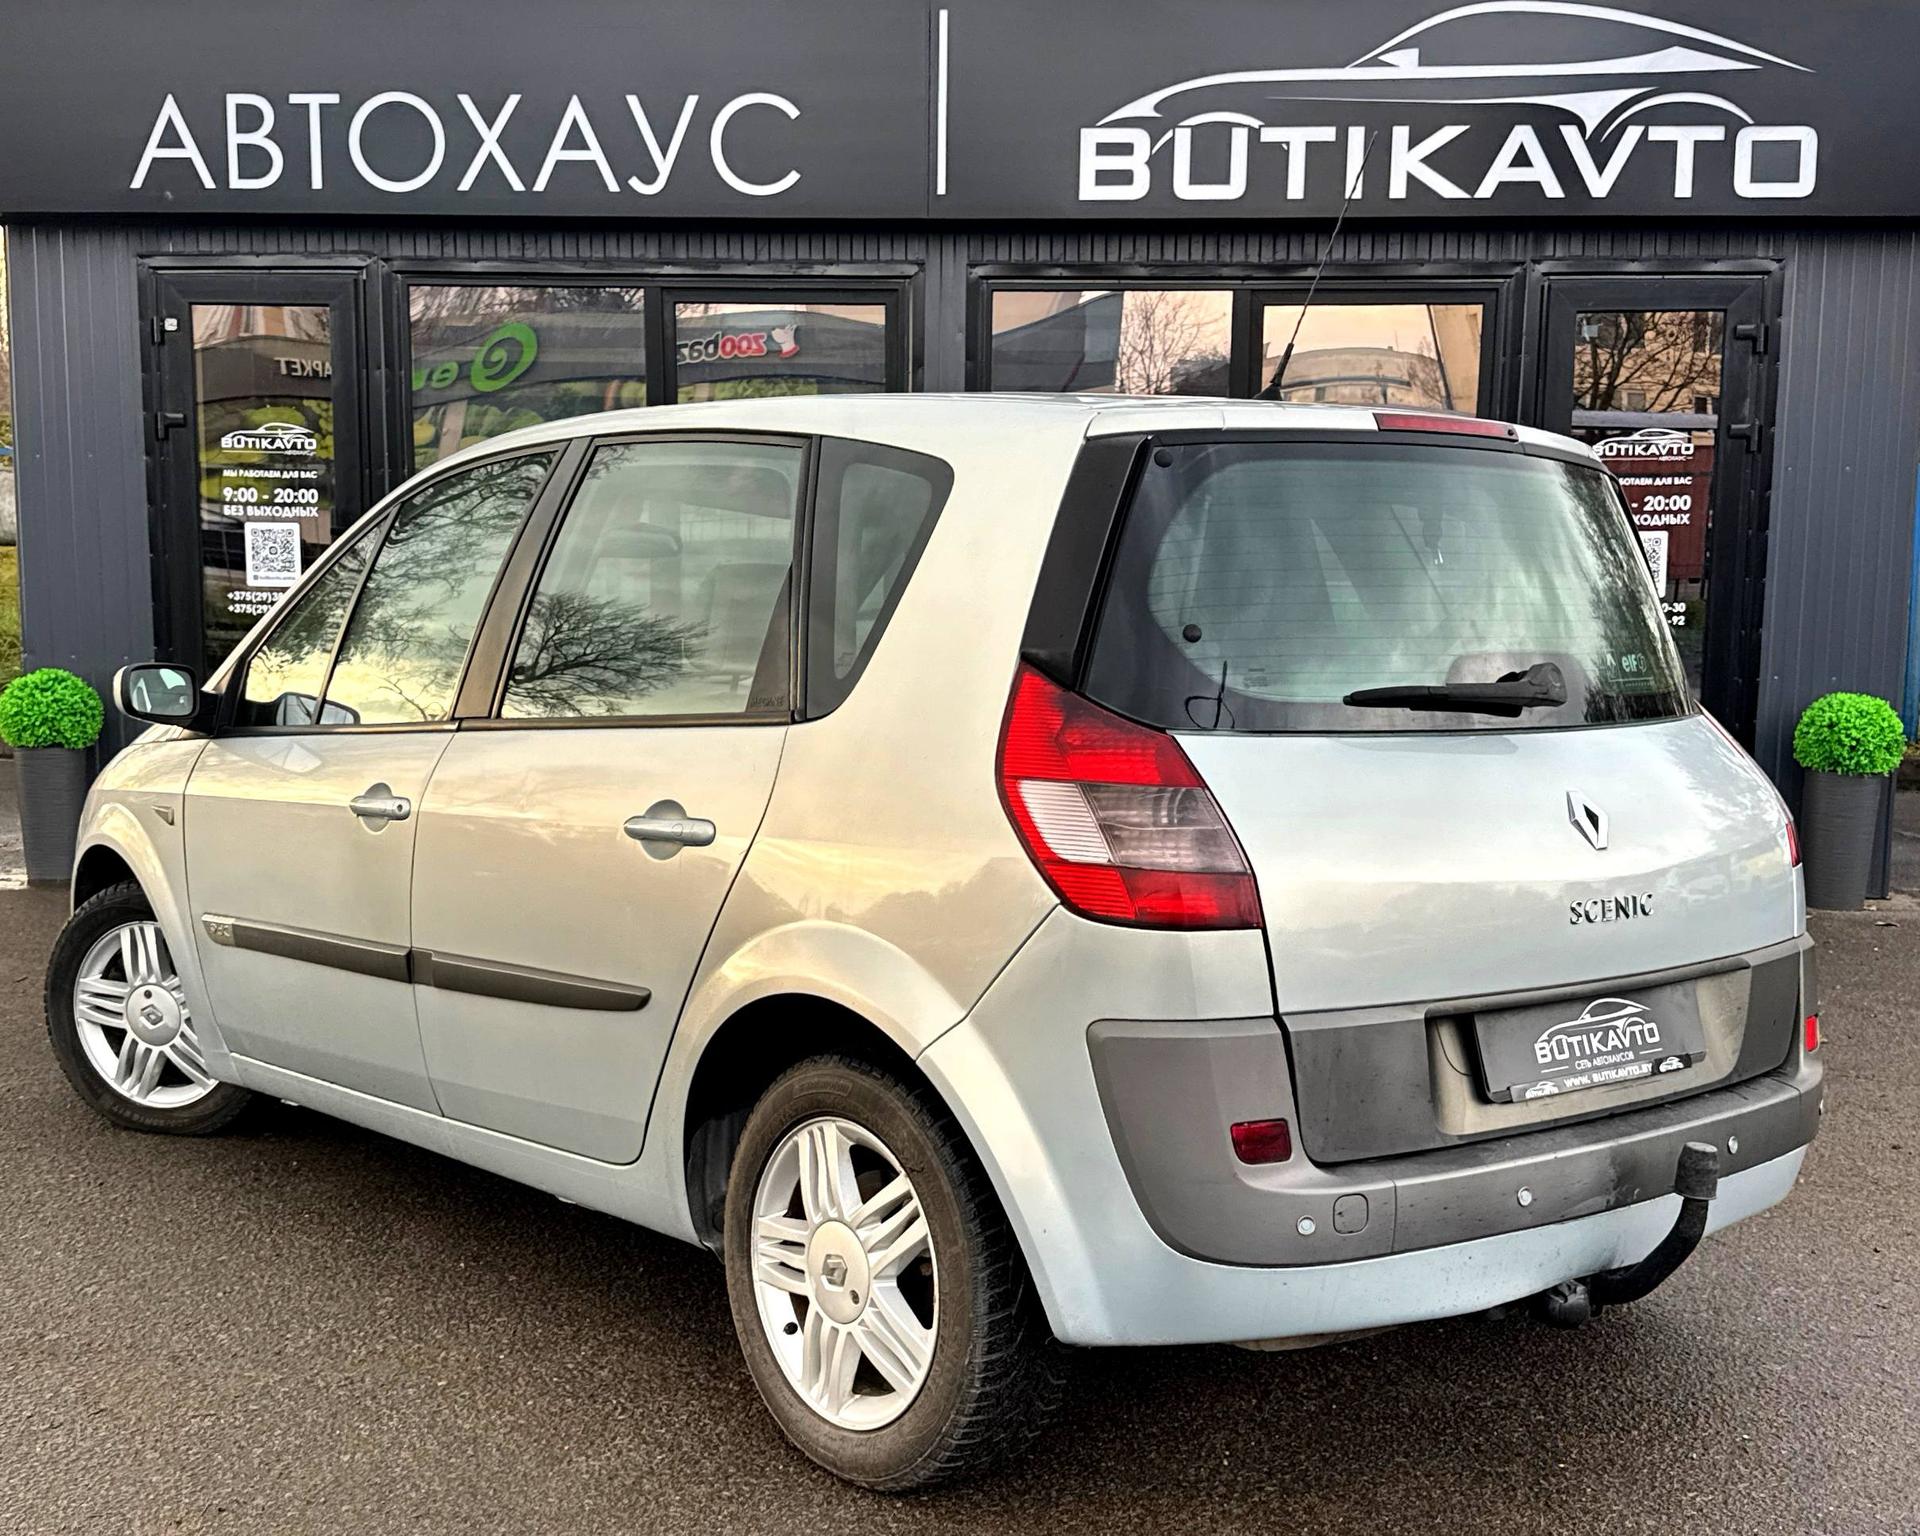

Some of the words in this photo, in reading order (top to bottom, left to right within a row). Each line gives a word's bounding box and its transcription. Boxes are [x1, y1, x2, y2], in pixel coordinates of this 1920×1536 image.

[129, 91, 801, 197] АВТОХАУС
[1078, 123, 1818, 200] BUTIKAVTO
[221, 437, 317, 449] BUTIKAVTO
[222, 469, 238, 477] МЫ
[239, 469, 281, 478] РАБОТАЕМ
[281, 470, 299, 479] ДЛЯ
[300, 470, 318, 479] ВАС
[1619, 477, 1653, 486] БОТАЕМ
[1653, 477, 1673, 486] ДЛЯ
[1673, 476, 1693, 485] ВАС
[223, 486, 258, 503] 9:00
[273, 487, 319, 504] 20:00
[1643, 494, 1692, 511] 20:00
[223, 505, 244, 516] БЕЗ
[246, 505, 319, 518] ВЫХОДНЫХ
[1632, 513, 1691, 526] ХОДНЫХ
[227, 591, 284, 603] +375(29)3
[1569, 891, 1654, 925] SCENIC
[1534, 1022, 1661, 1064] BUTIKAVTO
